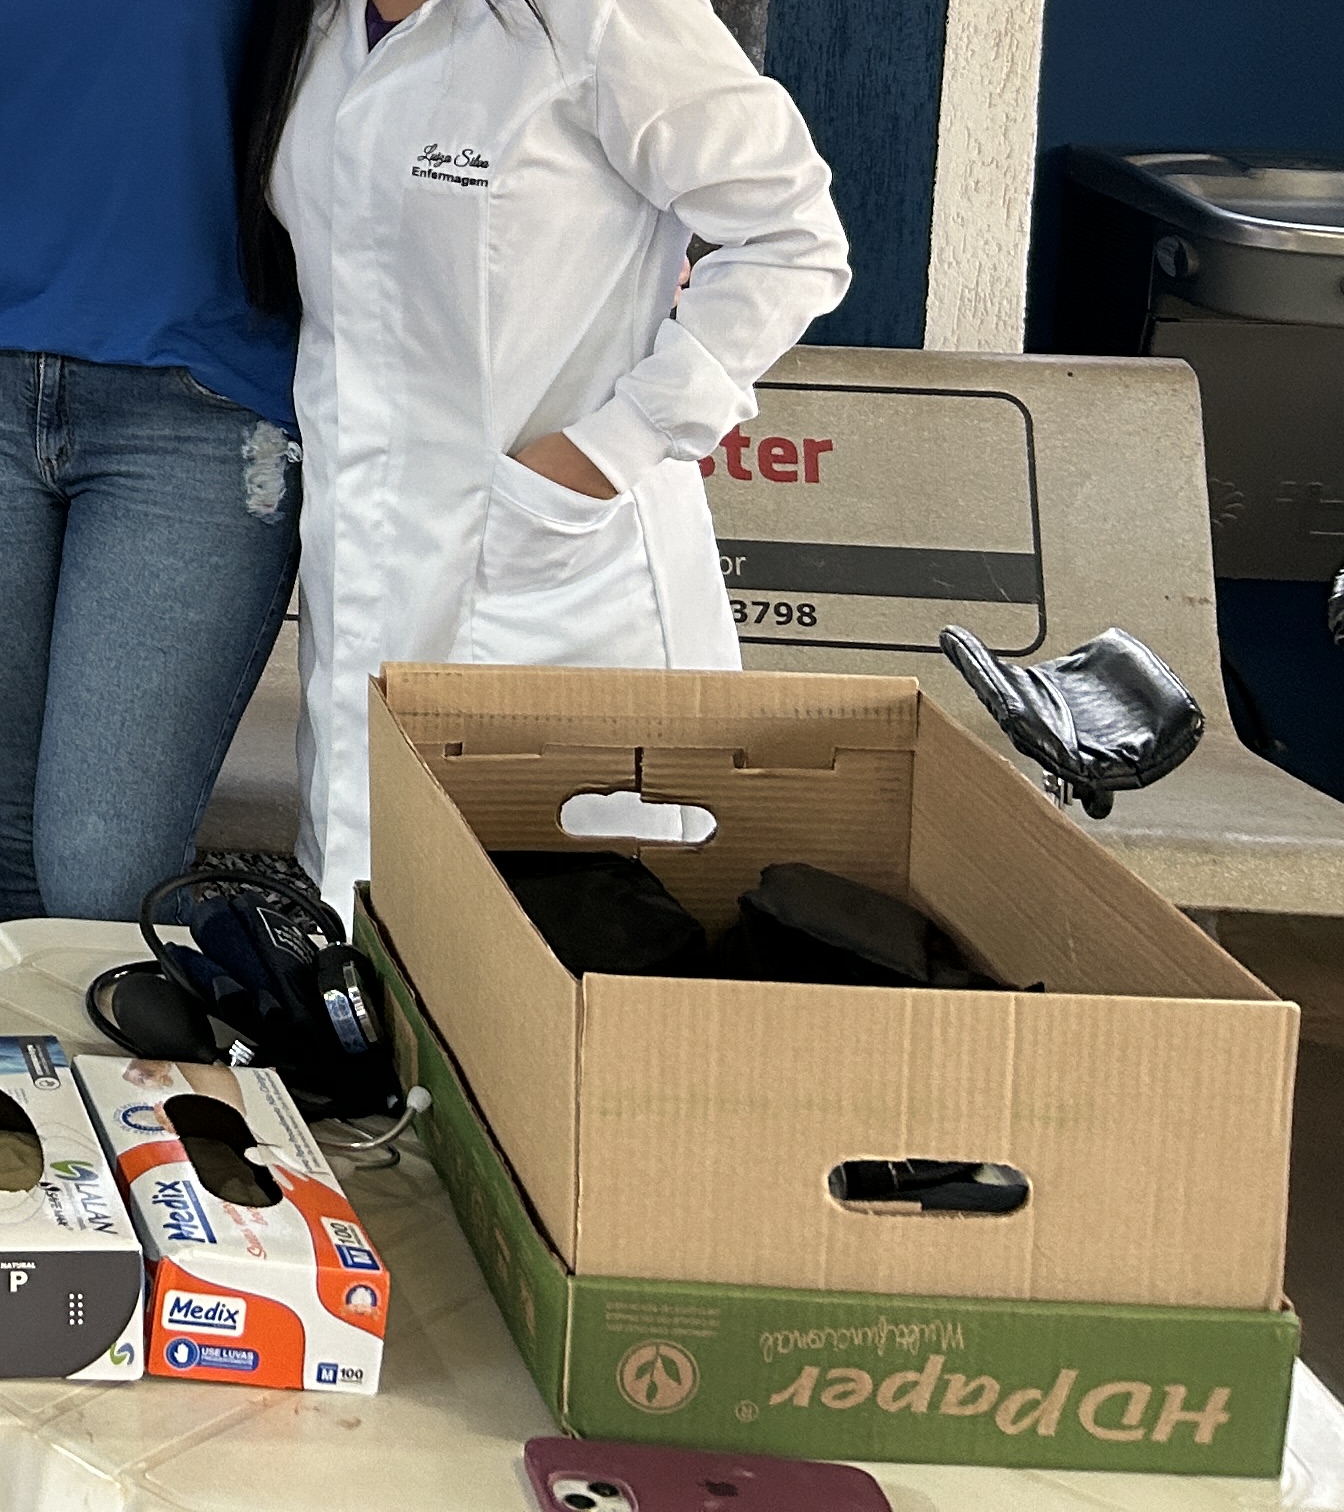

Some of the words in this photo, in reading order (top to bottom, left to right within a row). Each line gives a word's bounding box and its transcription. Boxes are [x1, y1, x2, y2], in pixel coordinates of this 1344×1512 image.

[454, 148, 489, 168] Silva
[412, 166, 488, 187] Enfermagem
[697, 424, 833, 483] ter
[720, 555, 747, 576] or
[730, 599, 817, 627] 3798
[74, 1183, 119, 1235] LALAN
[152, 1180, 206, 1243] Medix
[330, 1222, 353, 1244] 100
[10, 1271, 28, 1292] P
[169, 1296, 239, 1324] Medix
[760, 1316, 964, 1363] Multifuncional
[201, 1347, 222, 1357] USE
[223, 1348, 254, 1360] LUVAS
[321, 1368, 333, 1381] M
[340, 1368, 363, 1379] 100
